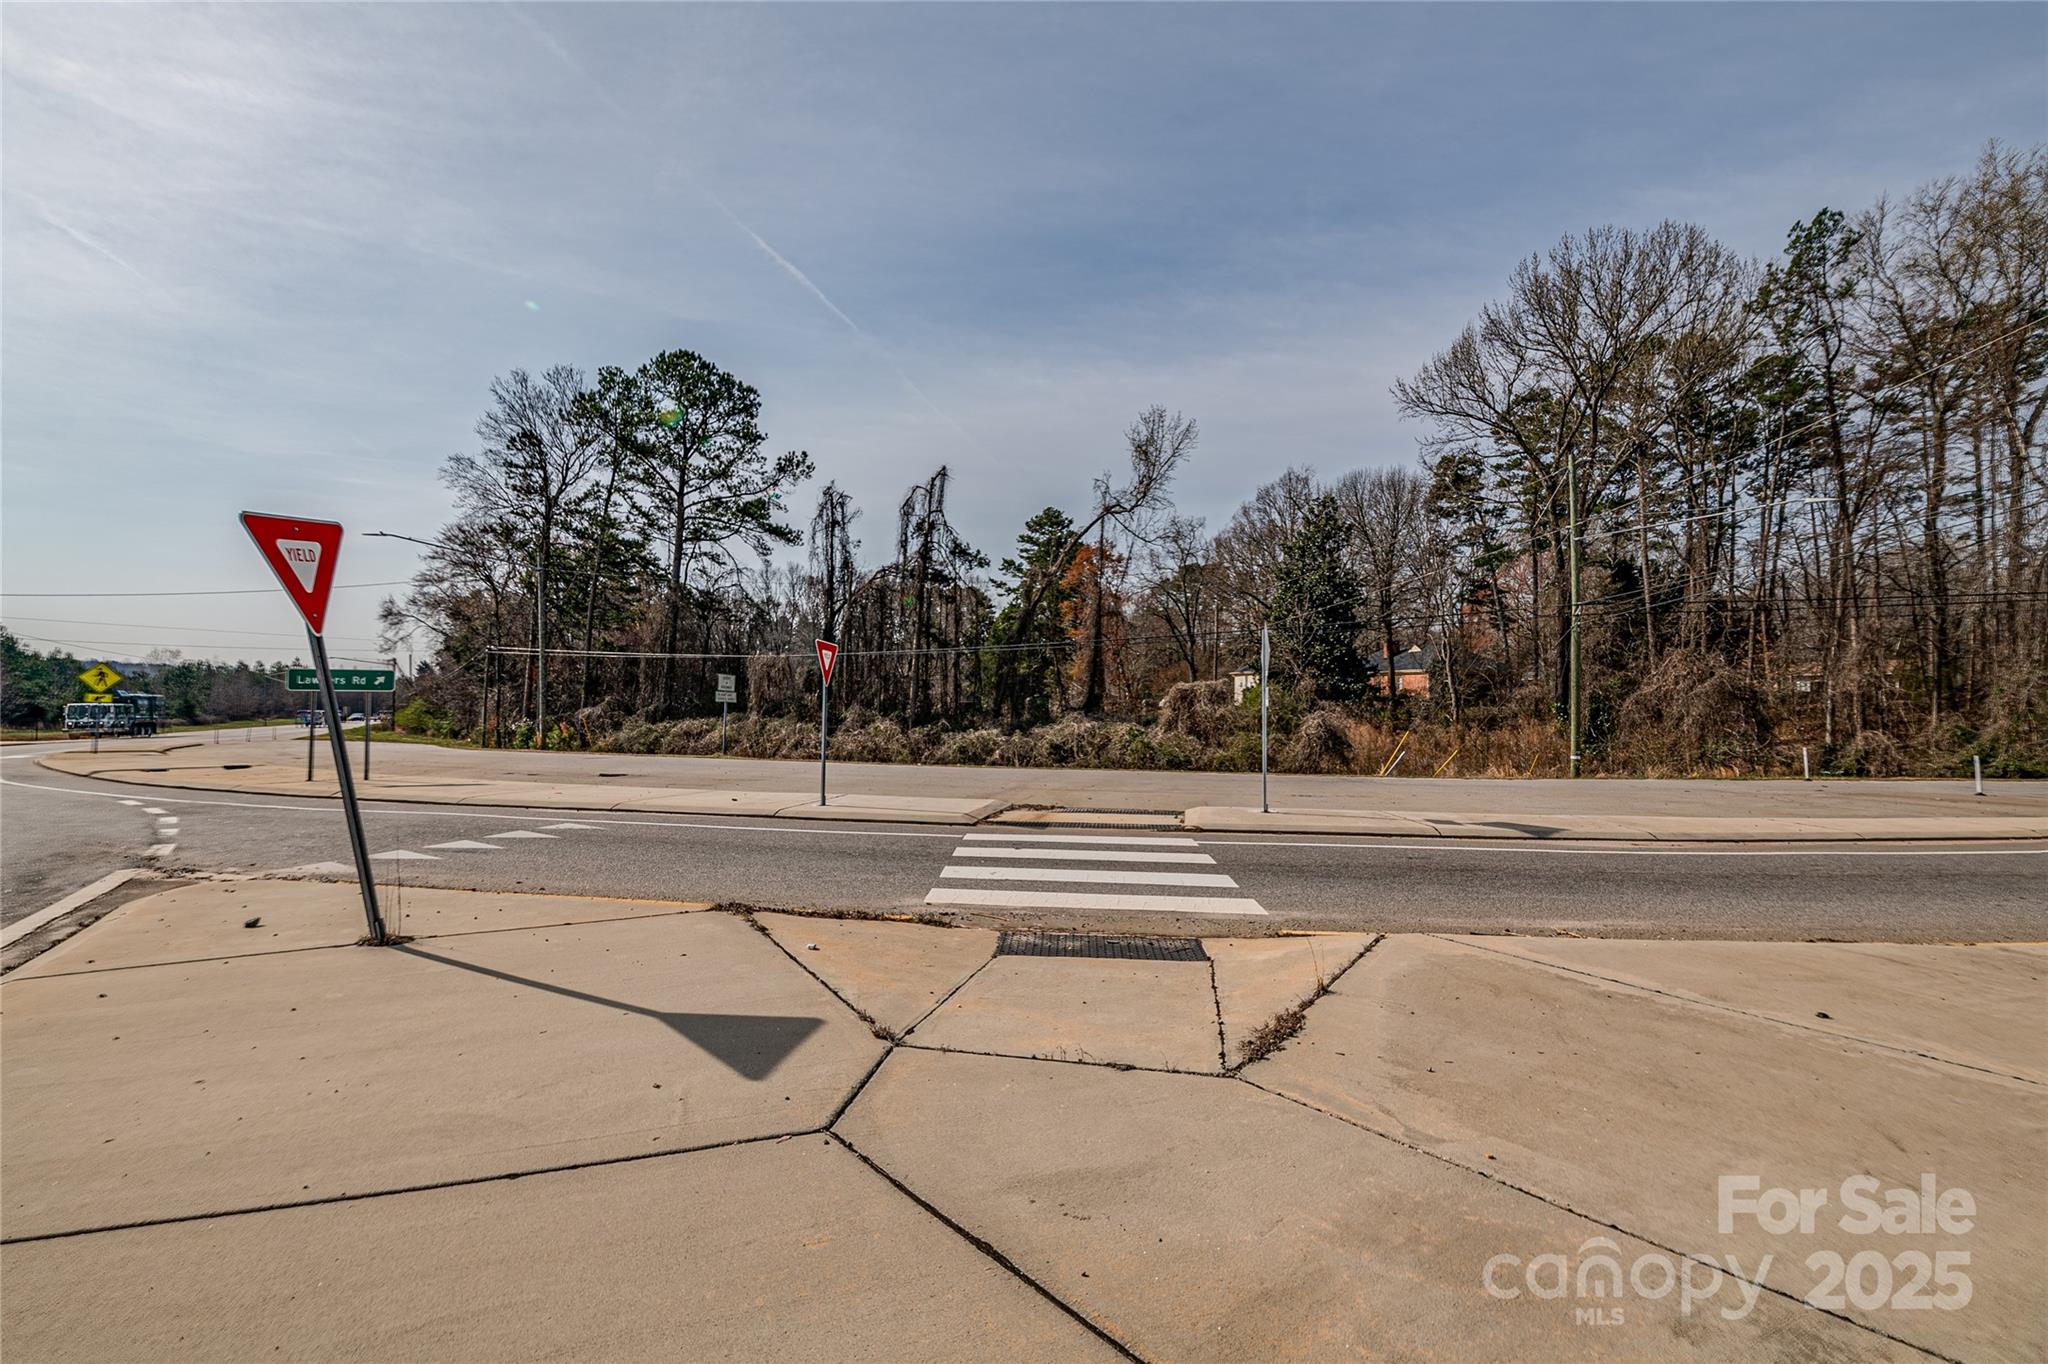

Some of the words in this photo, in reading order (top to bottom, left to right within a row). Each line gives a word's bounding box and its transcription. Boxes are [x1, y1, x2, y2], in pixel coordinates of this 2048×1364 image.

[285, 548, 316, 563] YIELD
[297, 675, 346, 685] Lawrs
[352, 676, 367, 685] Rd
